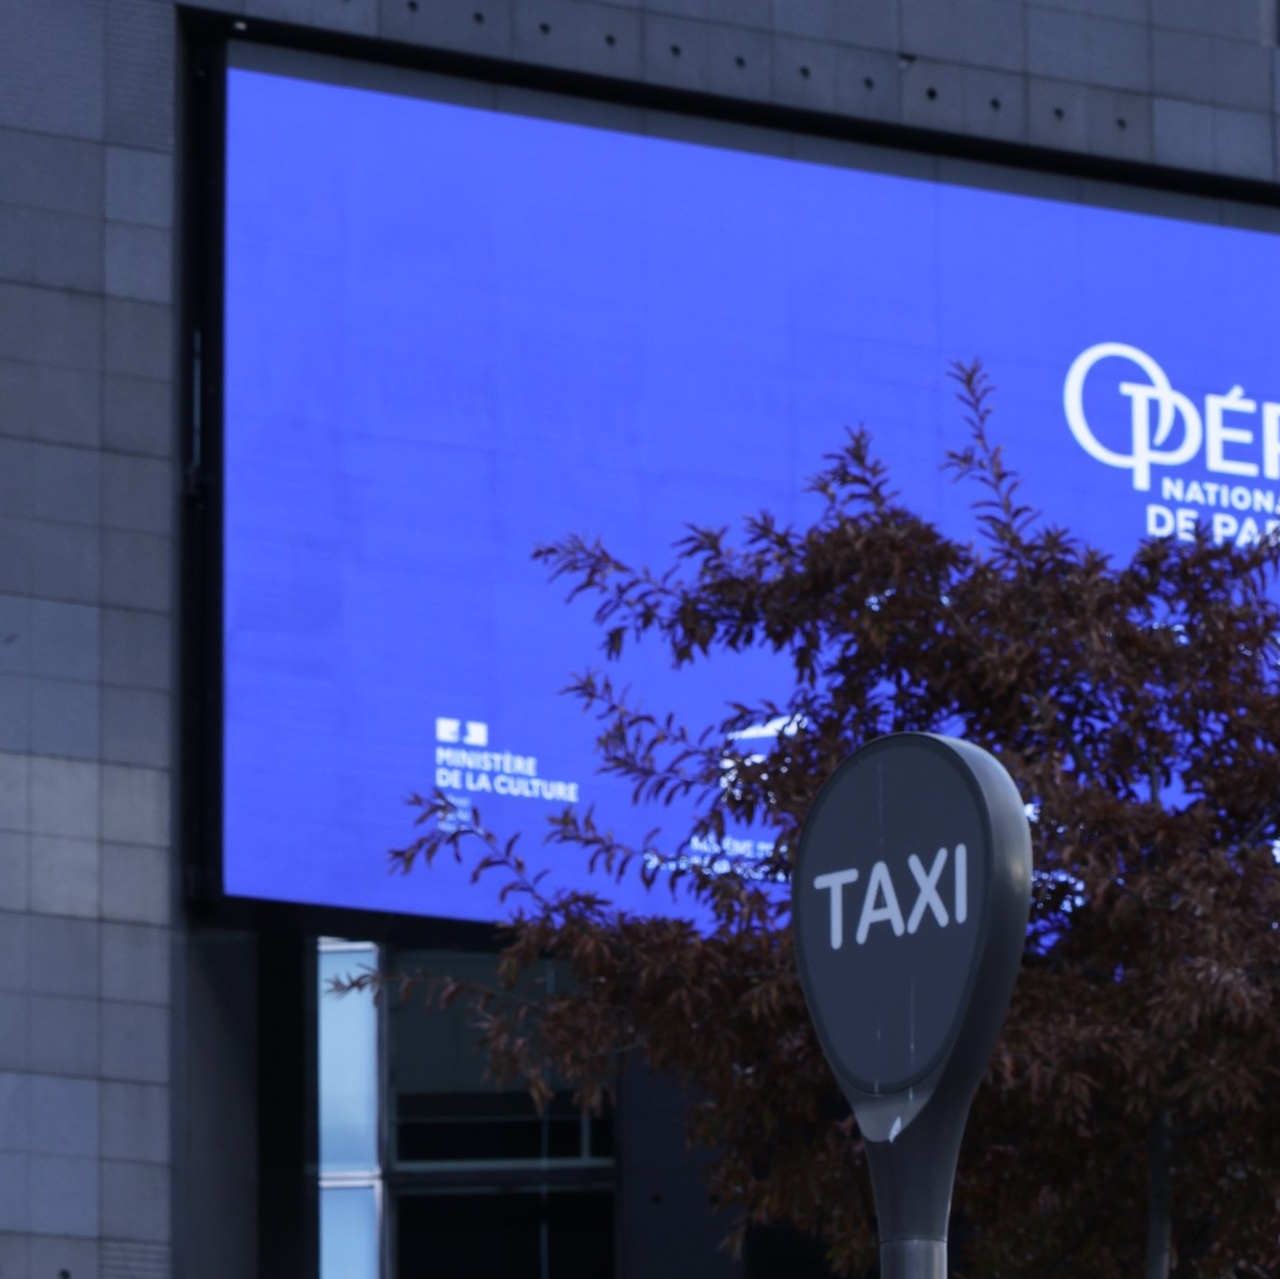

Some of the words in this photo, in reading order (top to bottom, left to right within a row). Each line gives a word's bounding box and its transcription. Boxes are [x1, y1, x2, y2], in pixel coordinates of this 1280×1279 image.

[1146, 504, 1199, 542] DE
[435, 746, 538, 777] MINISTÈRE
[435, 767, 463, 790] DE
[465, 771, 492, 793] LA
[493, 774, 579, 803] CULTURE
[813, 843, 968, 950] TAXI
